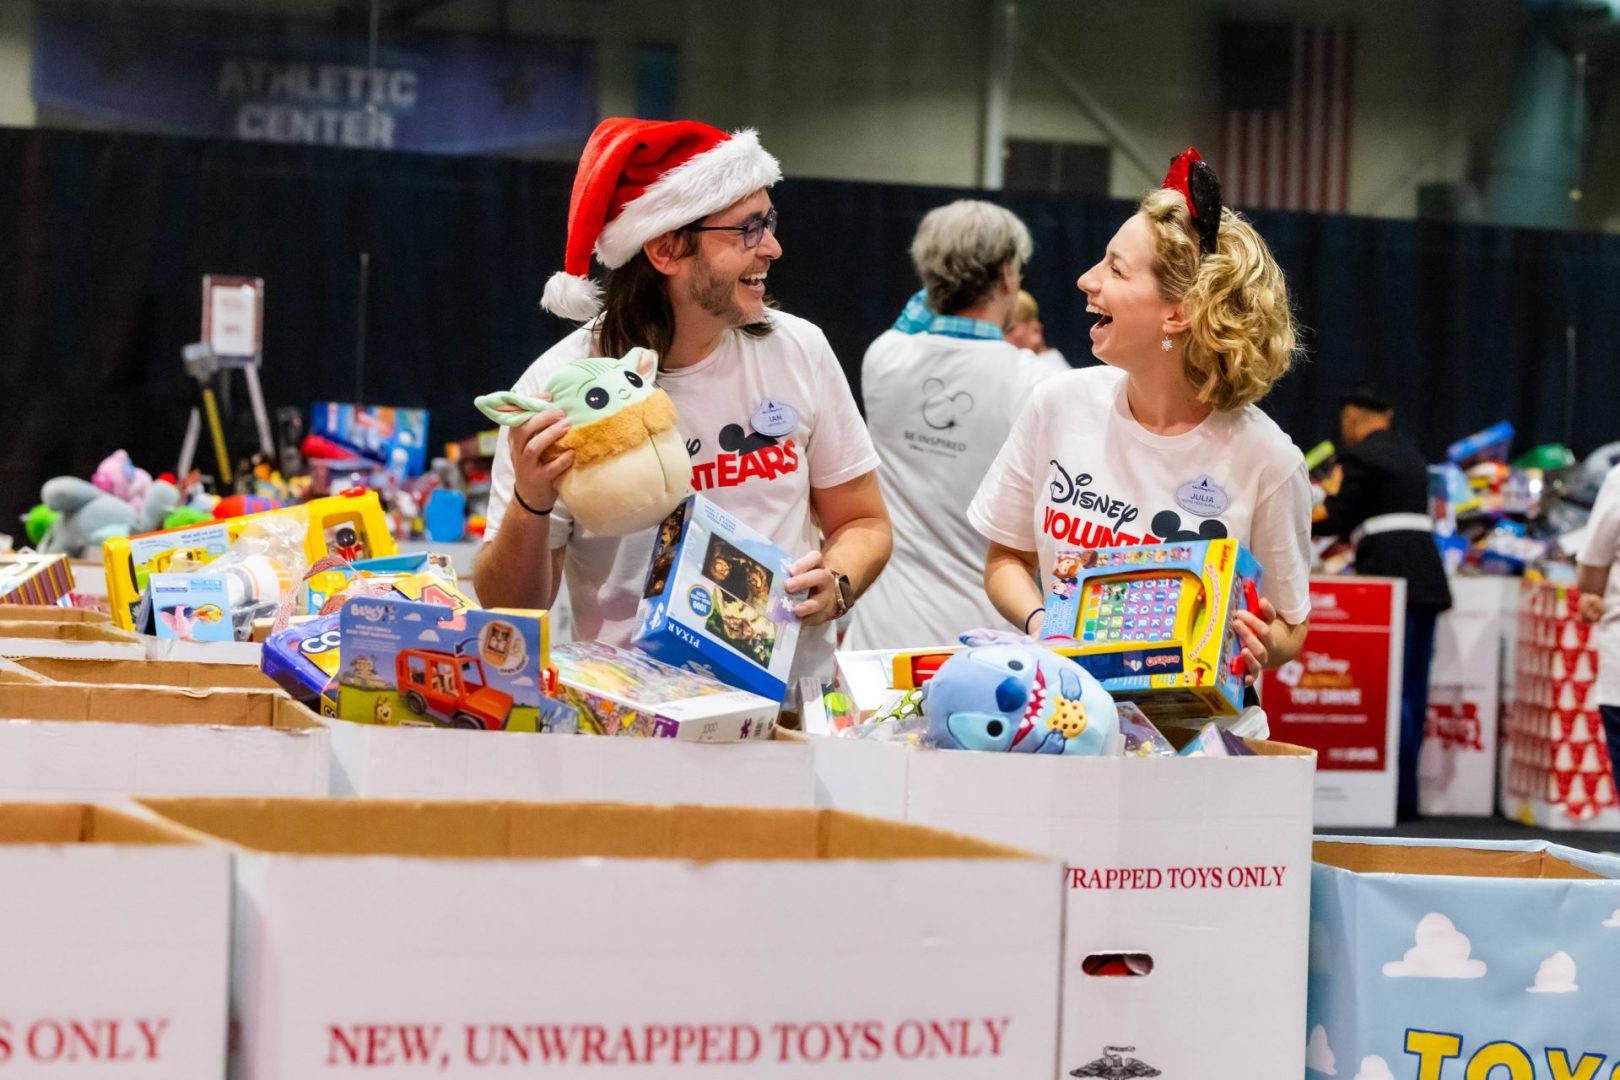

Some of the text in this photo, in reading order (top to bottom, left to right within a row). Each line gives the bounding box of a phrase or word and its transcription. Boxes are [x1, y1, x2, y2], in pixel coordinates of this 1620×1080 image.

[219, 61, 416, 107] ATHLETIC
[236, 103, 394, 148] CENTER
[769, 414, 782, 422] IAN
[918, 434, 967, 452] INSPIRED
[1190, 493, 1214, 503] JULIA
[667, 620, 701, 649] PIXAR
[1167, 866, 1223, 889] TOYS
[1228, 865, 1287, 888] ONLY
[27, 1018, 170, 1063] ONLY
[326, 1017, 1011, 1072] NEW, UNWRAPPED TOYS ONLY
